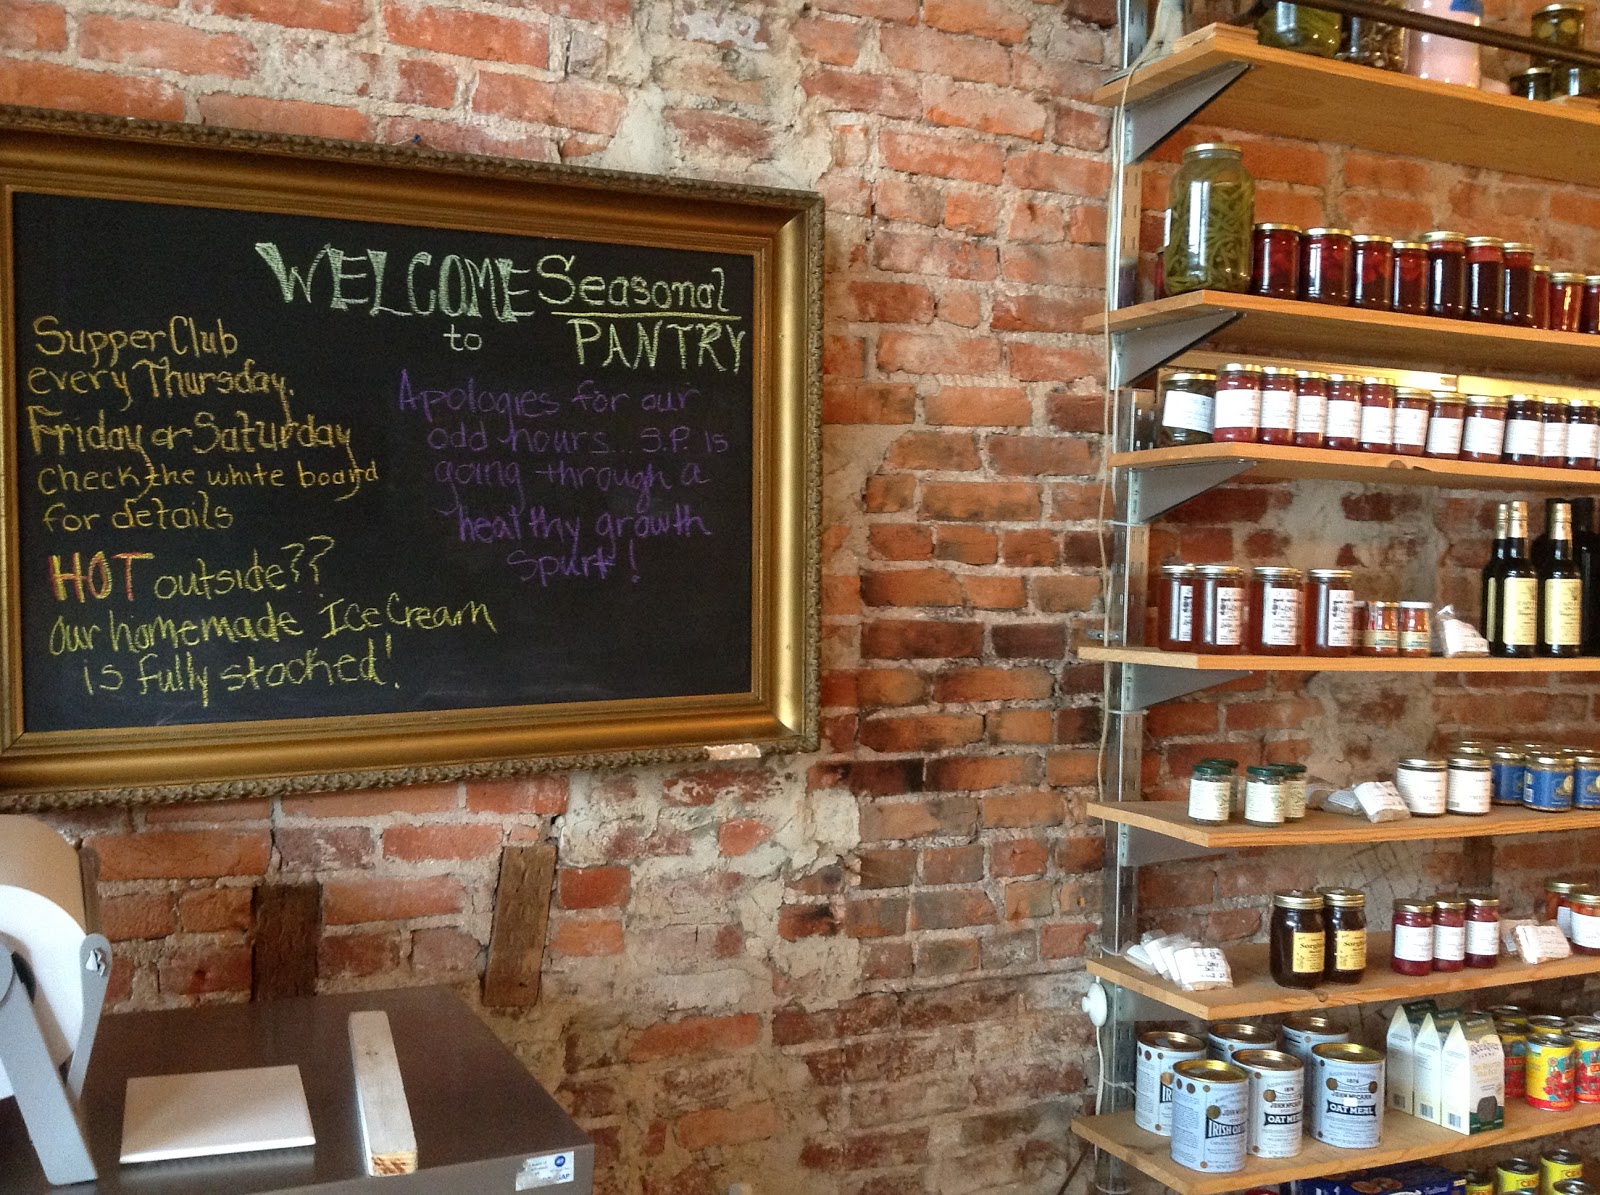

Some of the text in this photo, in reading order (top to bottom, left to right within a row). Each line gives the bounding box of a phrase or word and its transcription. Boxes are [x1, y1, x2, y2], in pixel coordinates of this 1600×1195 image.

[255, 242, 729, 323] WELCOME Seasonal
[33, 315, 238, 368] Supper Club
[444, 318, 746, 375] to PANTRY
[28, 356, 294, 420] every Thursday.
[399, 369, 701, 434] Apologies for our
[28, 405, 356, 482] Friday or Saturday
[427, 421, 488, 451] odd
[640, 427, 690, 452] S.P.
[705, 430, 728, 453] is
[37, 461, 379, 496] Check the white board
[435, 460, 711, 515] going through a
[44, 491, 233, 531] for details
[458, 503, 713, 560] healthy growth
[49, 535, 336, 602] HOT outside??
[110, 602, 304, 654] homemade
[318, 598, 383, 639] Ice
[386, 592, 498, 634] Cream
[84, 632, 401, 708] is fully stocked!
[1208, 1119, 1232, 1139] IRISH
[1267, 1115, 1287, 1124] OAT
[1329, 1103, 1374, 1115] OAT MEAL
